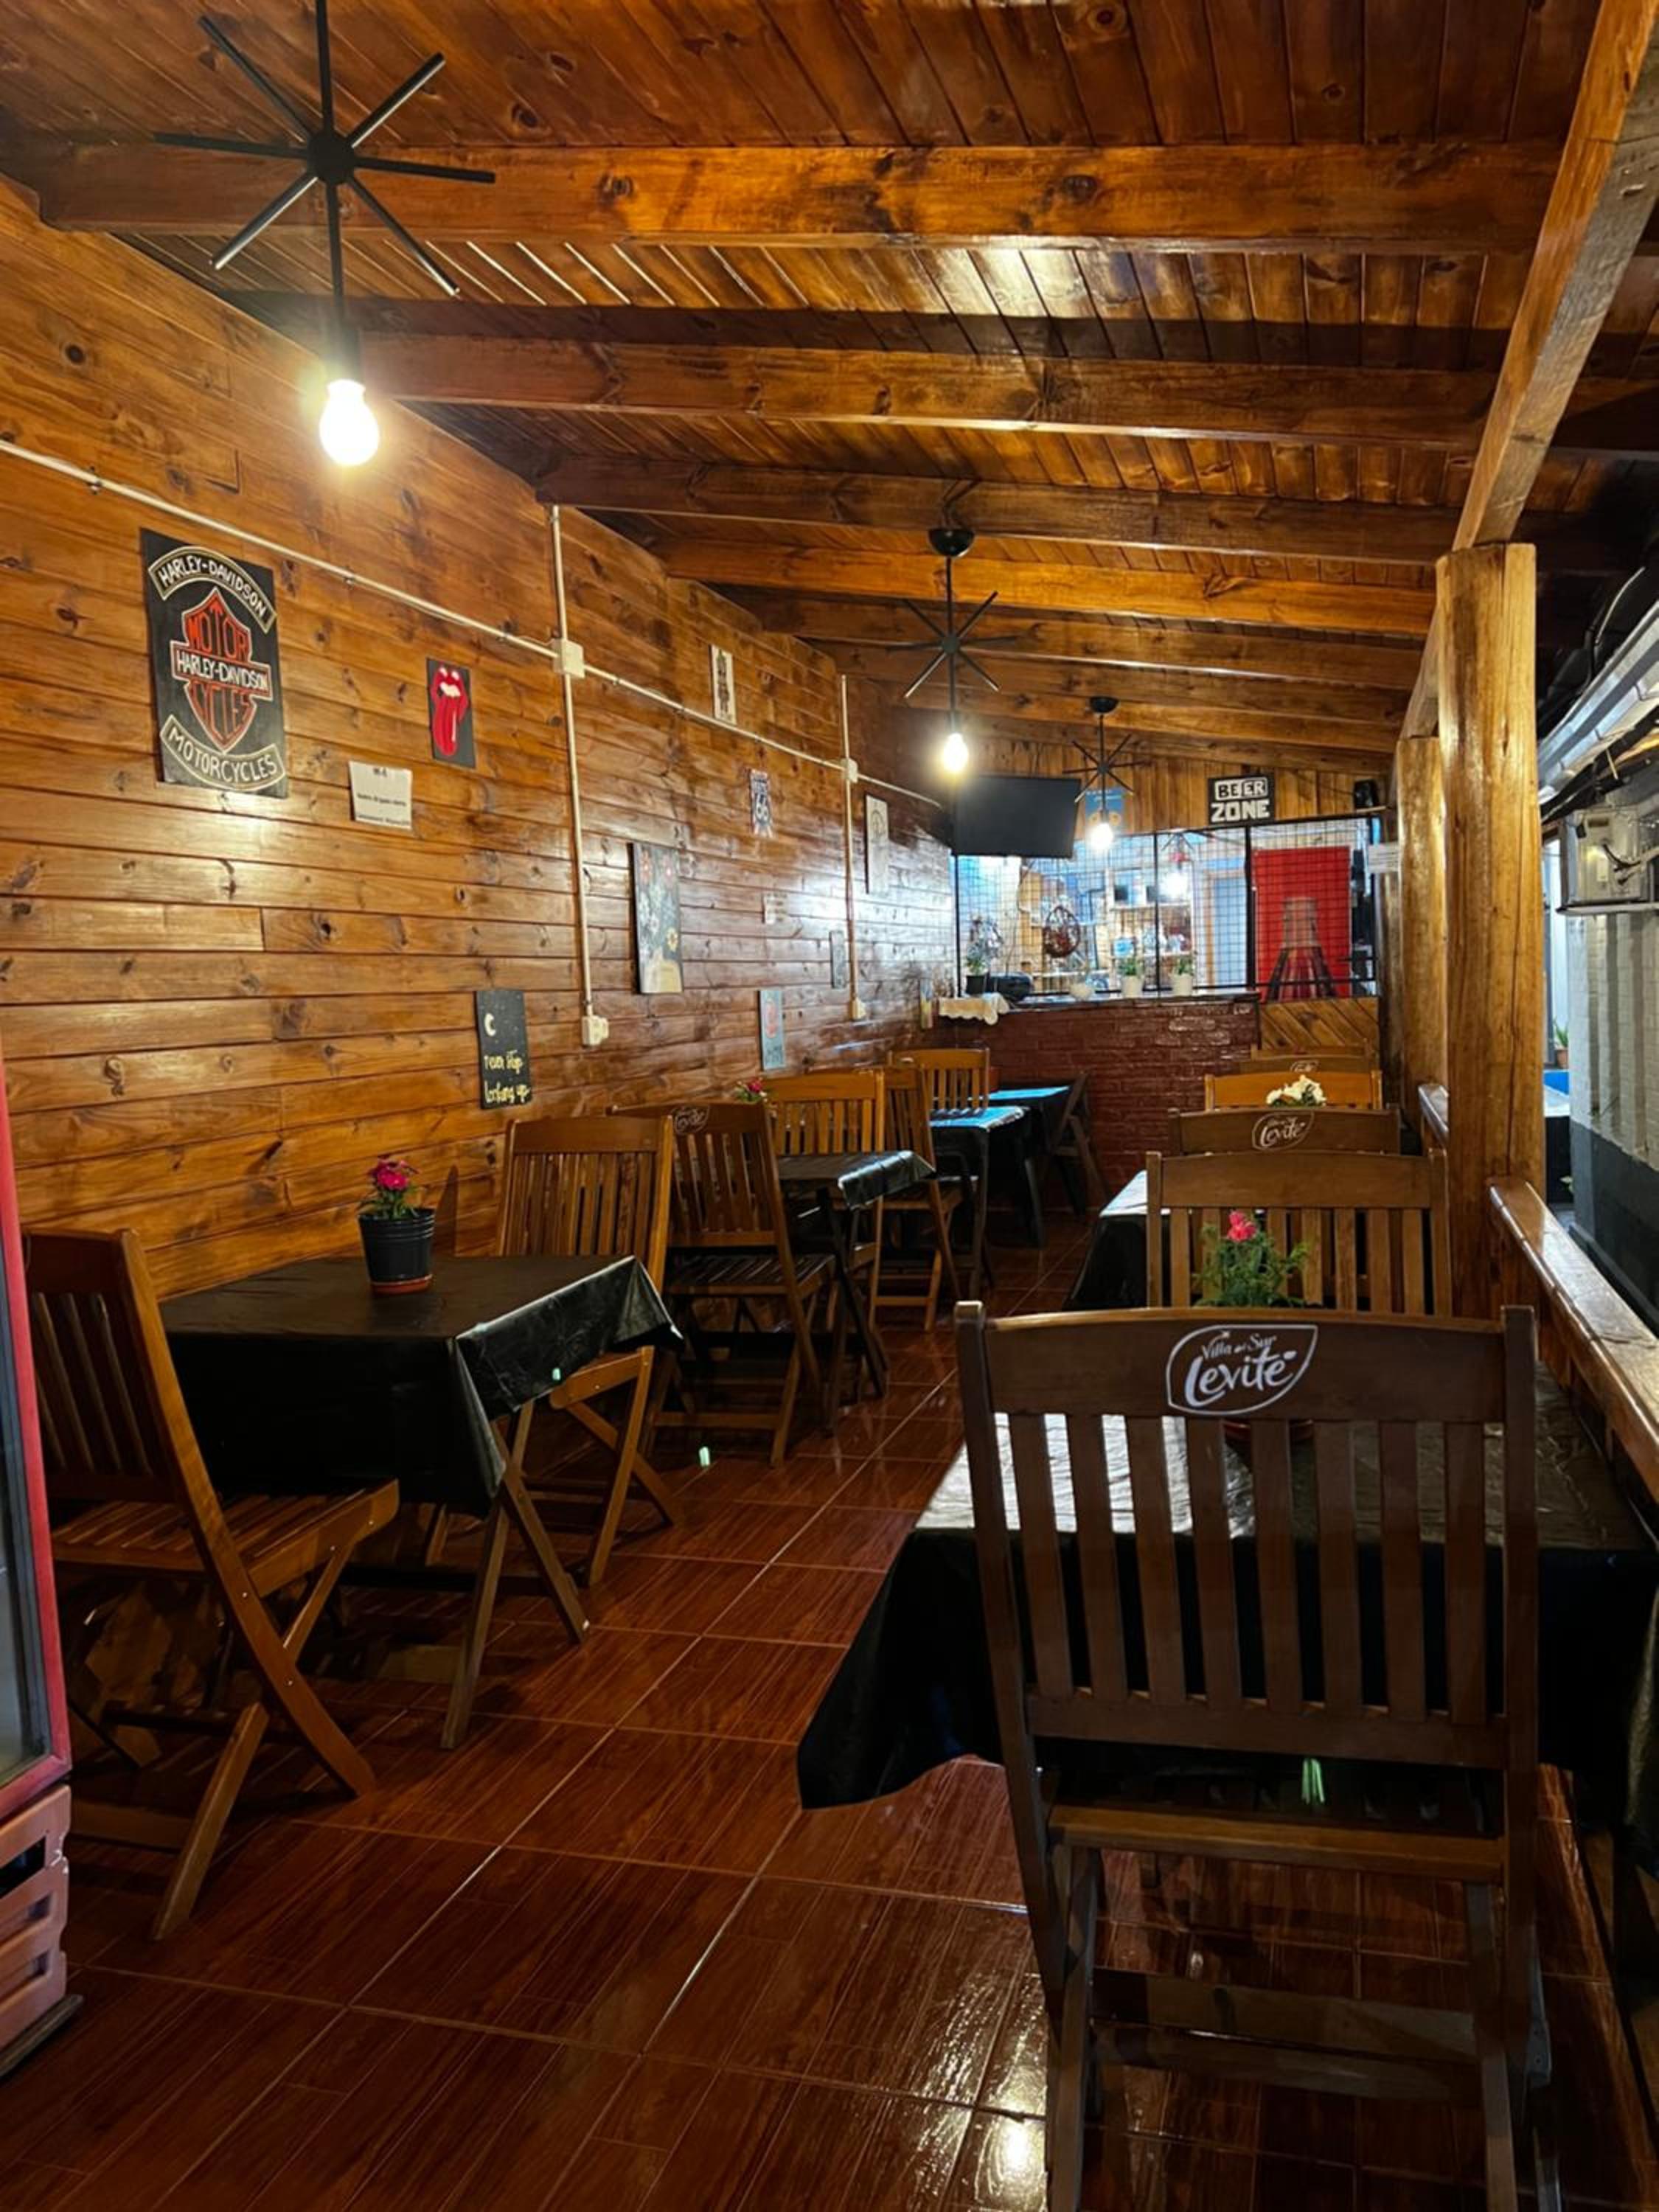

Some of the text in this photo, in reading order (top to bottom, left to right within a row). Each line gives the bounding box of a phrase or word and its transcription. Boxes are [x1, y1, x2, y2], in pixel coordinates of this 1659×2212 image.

[158, 554, 268, 619] HARLEY-DAVIDSON
[187, 601, 249, 661] MOTOR
[176, 649, 268, 692] HARLEY-DAVIDSON
[167, 726, 277, 783] MOTORCYCLES
[1211, 799, 1270, 822] ZONE
[1218, 780, 1265, 798] BEER
[1201, 1330, 1232, 1360] Villa
